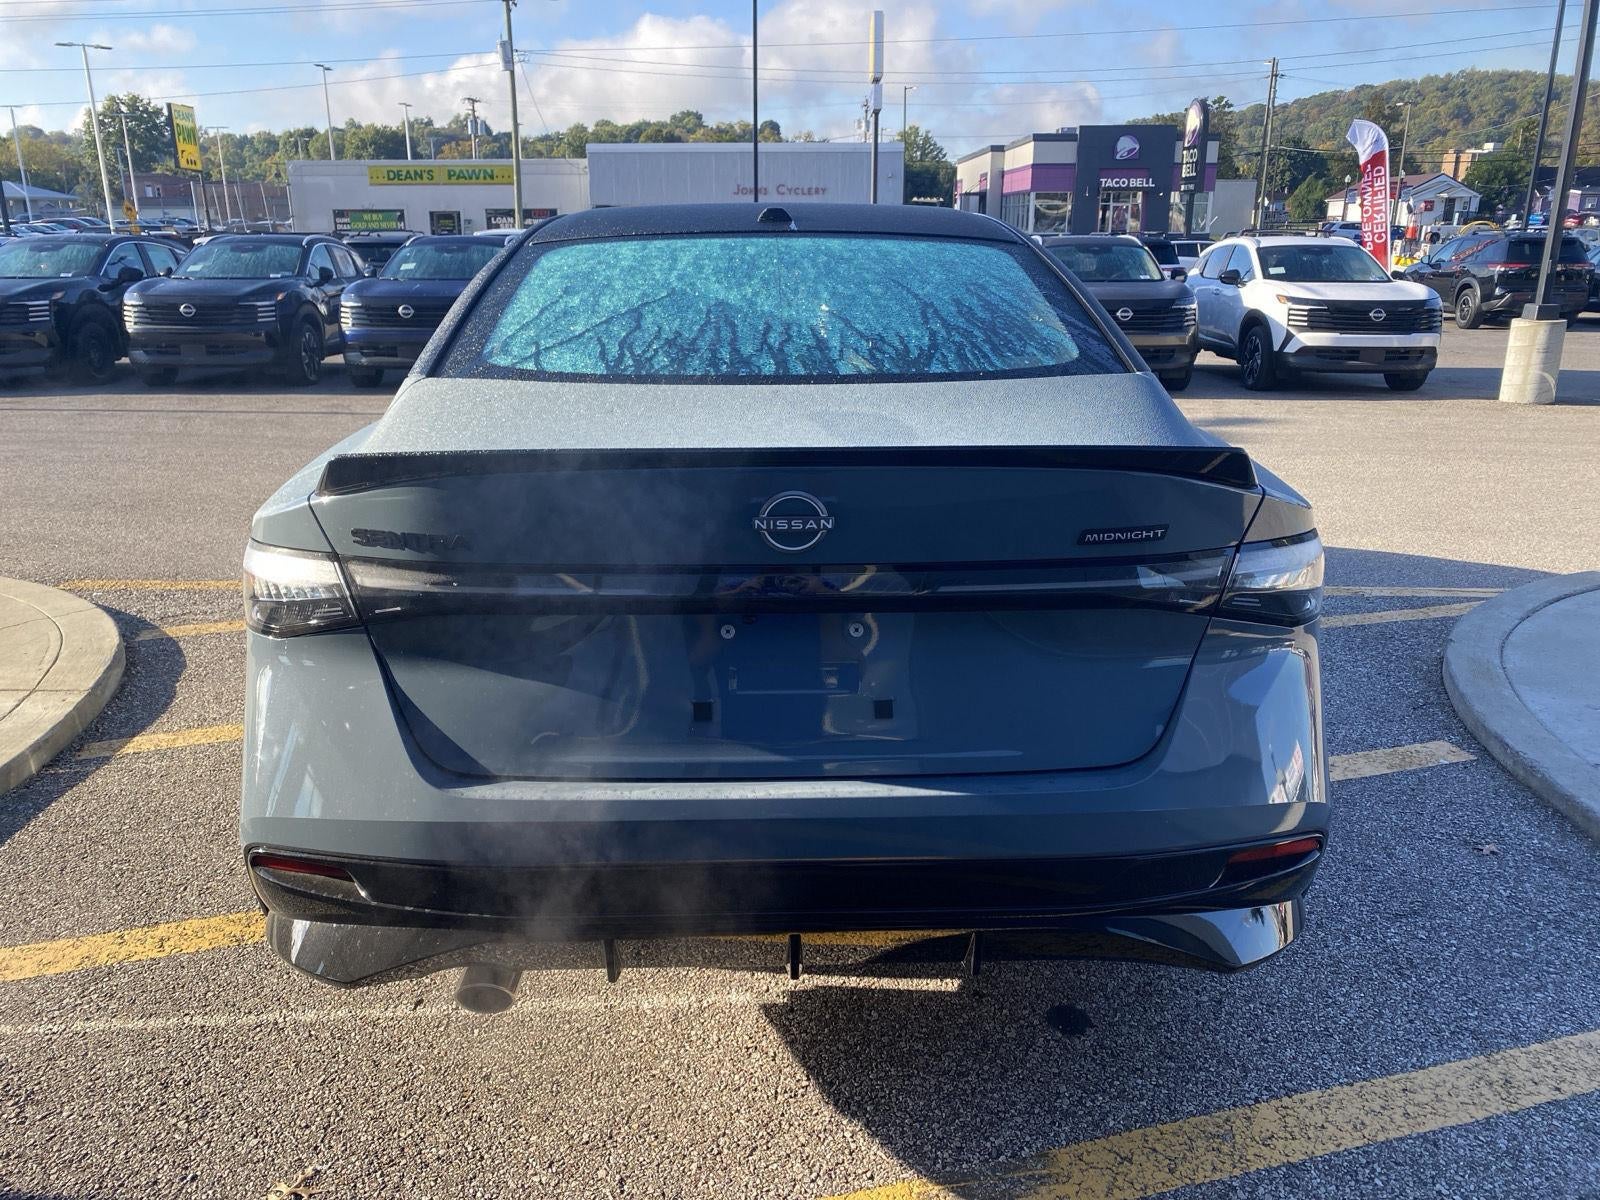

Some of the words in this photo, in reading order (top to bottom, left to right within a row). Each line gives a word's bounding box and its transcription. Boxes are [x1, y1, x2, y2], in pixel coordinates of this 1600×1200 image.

[176, 123, 197, 146] PAWN
[1183, 149, 1198, 163] TACO
[386, 169, 434, 181] DEAN'S
[447, 169, 495, 181] PAWN
[1182, 163, 1197, 177] BELL
[1100, 178, 1128, 187] TACO
[1129, 178, 1156, 187] BELL
[754, 519, 833, 530] NISSAN
[1085, 529, 1165, 542] MIDNIGHT
